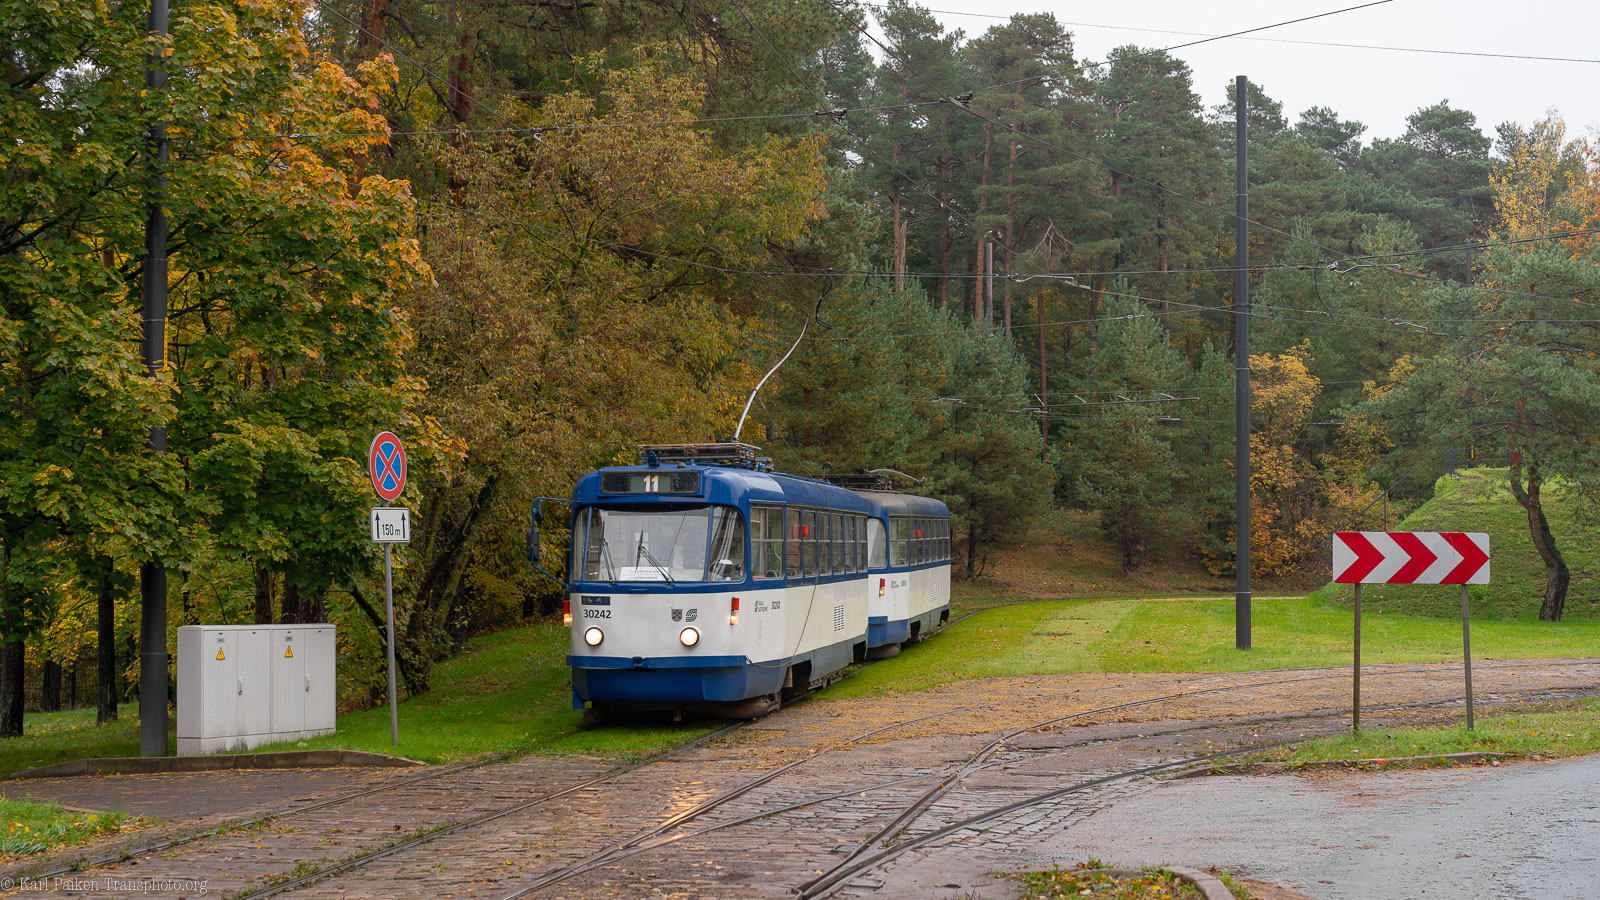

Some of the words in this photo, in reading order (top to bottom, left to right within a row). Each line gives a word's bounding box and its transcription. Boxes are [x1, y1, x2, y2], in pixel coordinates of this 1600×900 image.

[643, 474, 659, 492] 11
[382, 523, 394, 536] 150
[395, 528, 401, 536] m
[583, 609, 612, 619] 30242
